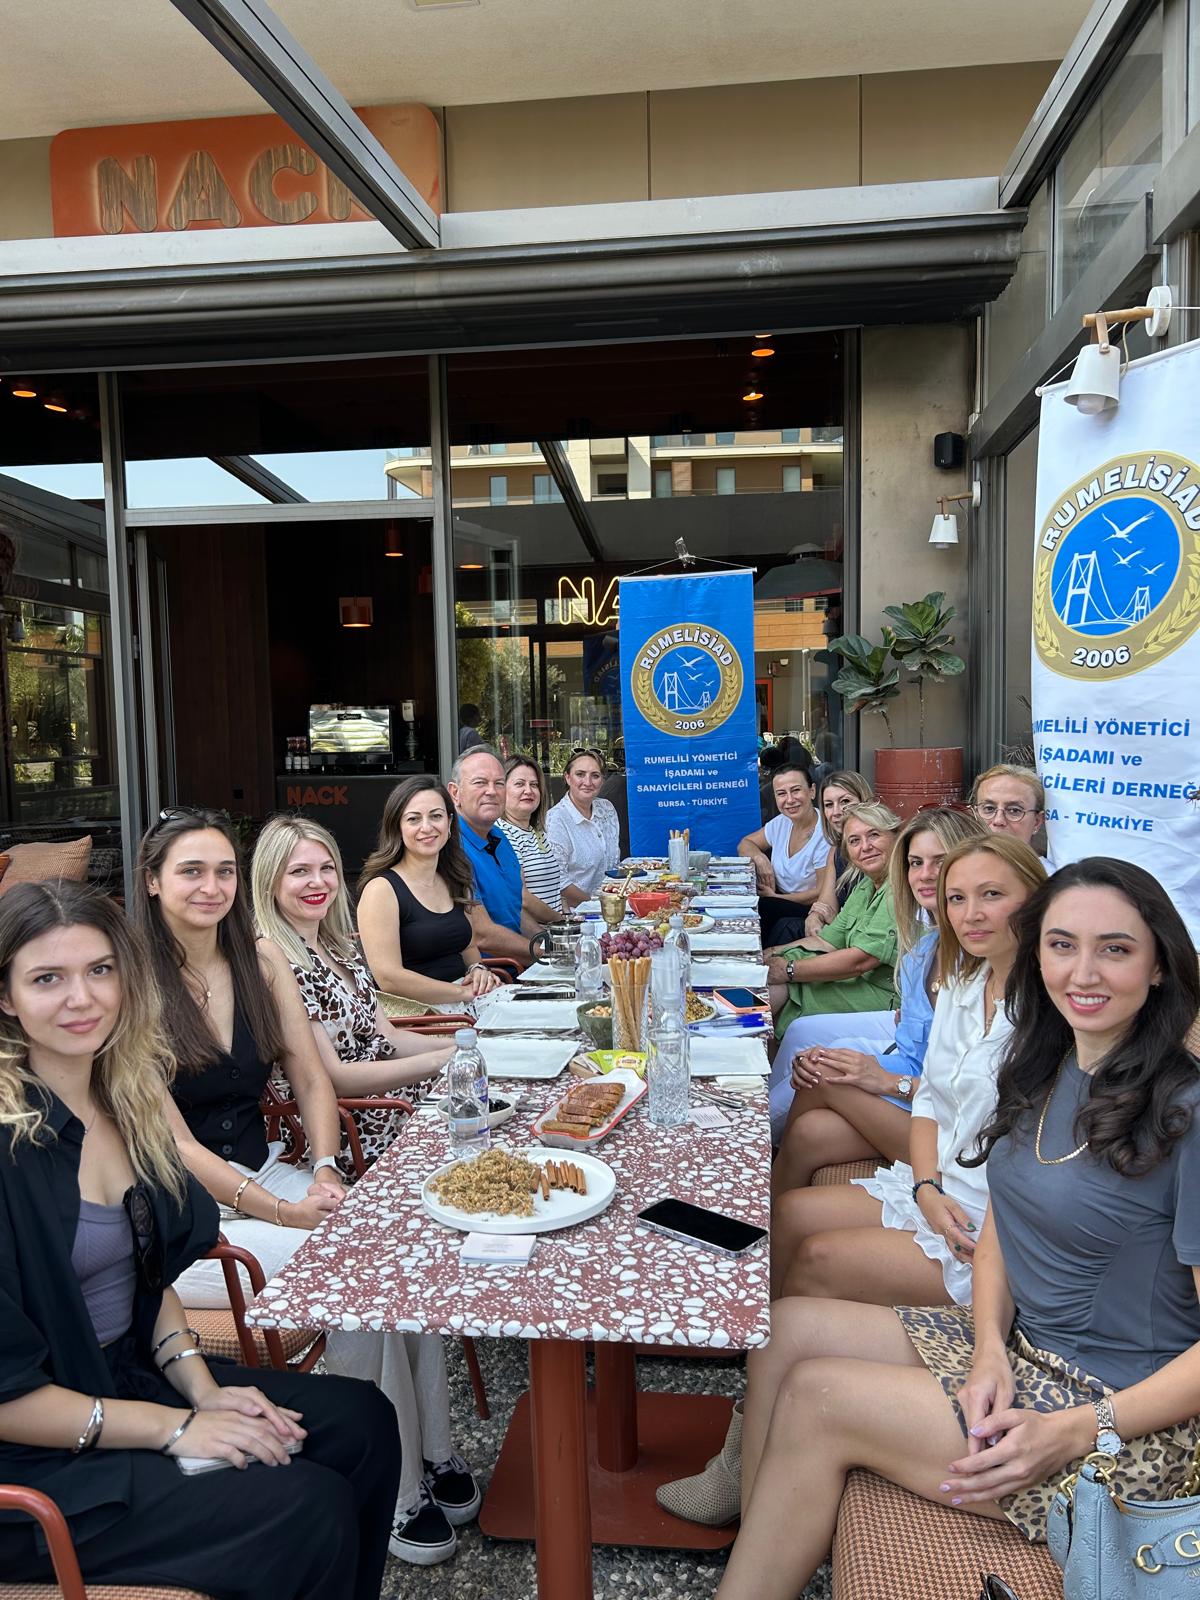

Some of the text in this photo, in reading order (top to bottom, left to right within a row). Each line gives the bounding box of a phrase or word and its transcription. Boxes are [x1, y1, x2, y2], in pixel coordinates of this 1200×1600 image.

[558, 576, 619, 626] NA
[639, 626, 734, 670] RUMELİSİAD
[1071, 645, 1131, 668] 2006
[675, 719, 705, 730] 2006
[1032, 716, 1190, 736] MELİLİ YÖNETİCİ
[644, 753, 689, 764] RUMELİLİ
[1039, 744, 1143, 766] İŞADAMI ve
[665, 768, 705, 779] İŞADAMI
[287, 785, 350, 806] NACK
[637, 778, 749, 793] SANAYİCİLERİ DERNEĞİ
[1112, 781, 1200, 800] DERNEĞ
[658, 800, 686, 808] BURSA
[691, 797, 728, 806] TÜRKİYE
[1075, 811, 1154, 832] TÜRKİYE
